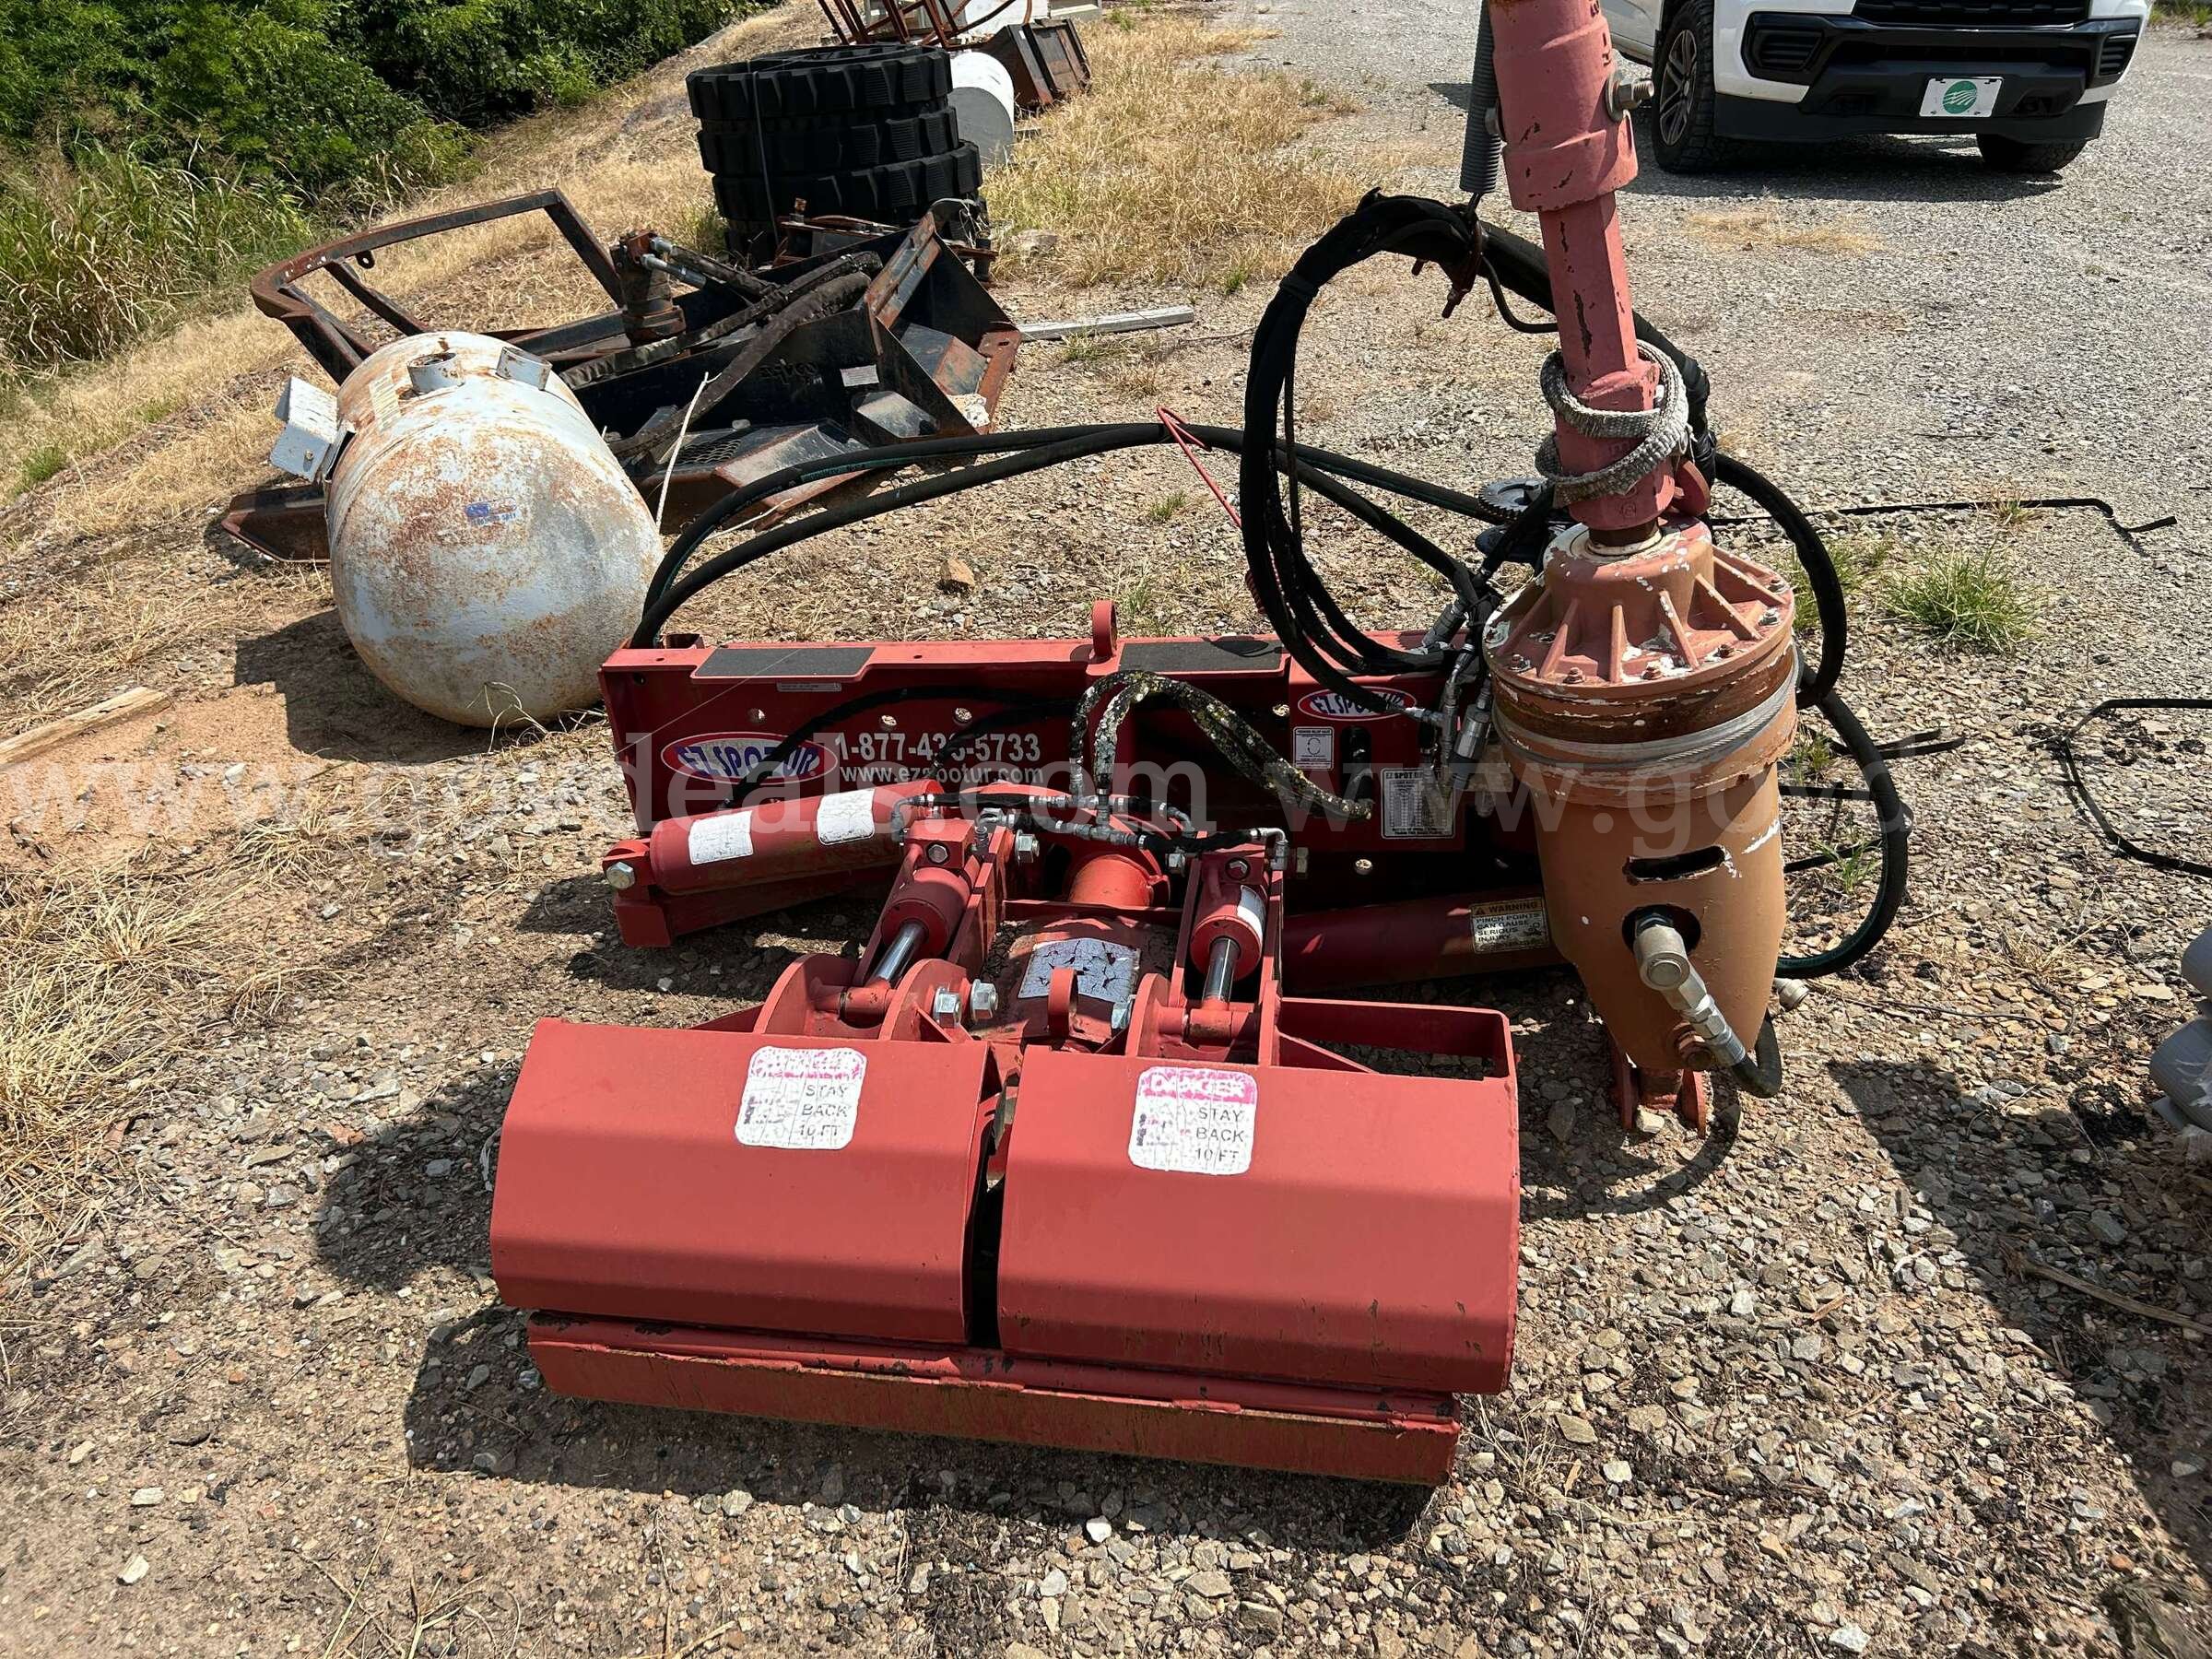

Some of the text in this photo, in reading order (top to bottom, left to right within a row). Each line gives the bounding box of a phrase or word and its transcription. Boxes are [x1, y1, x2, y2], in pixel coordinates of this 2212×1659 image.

[1488, 901, 1538, 913] WARNING
[1476, 912, 1540, 924] PINCH POINTS
[1477, 926, 1519, 936] SERIOUS
[1478, 934, 1512, 943] INJURY
[805, 1084, 849, 1099] STAY
[801, 1103, 849, 1118] BACK
[1198, 1107, 1245, 1123] STAY
[798, 1124, 817, 1136] 10
[1195, 1127, 1245, 1143] BACK
[1195, 1147, 1240, 1163] 10 FT
